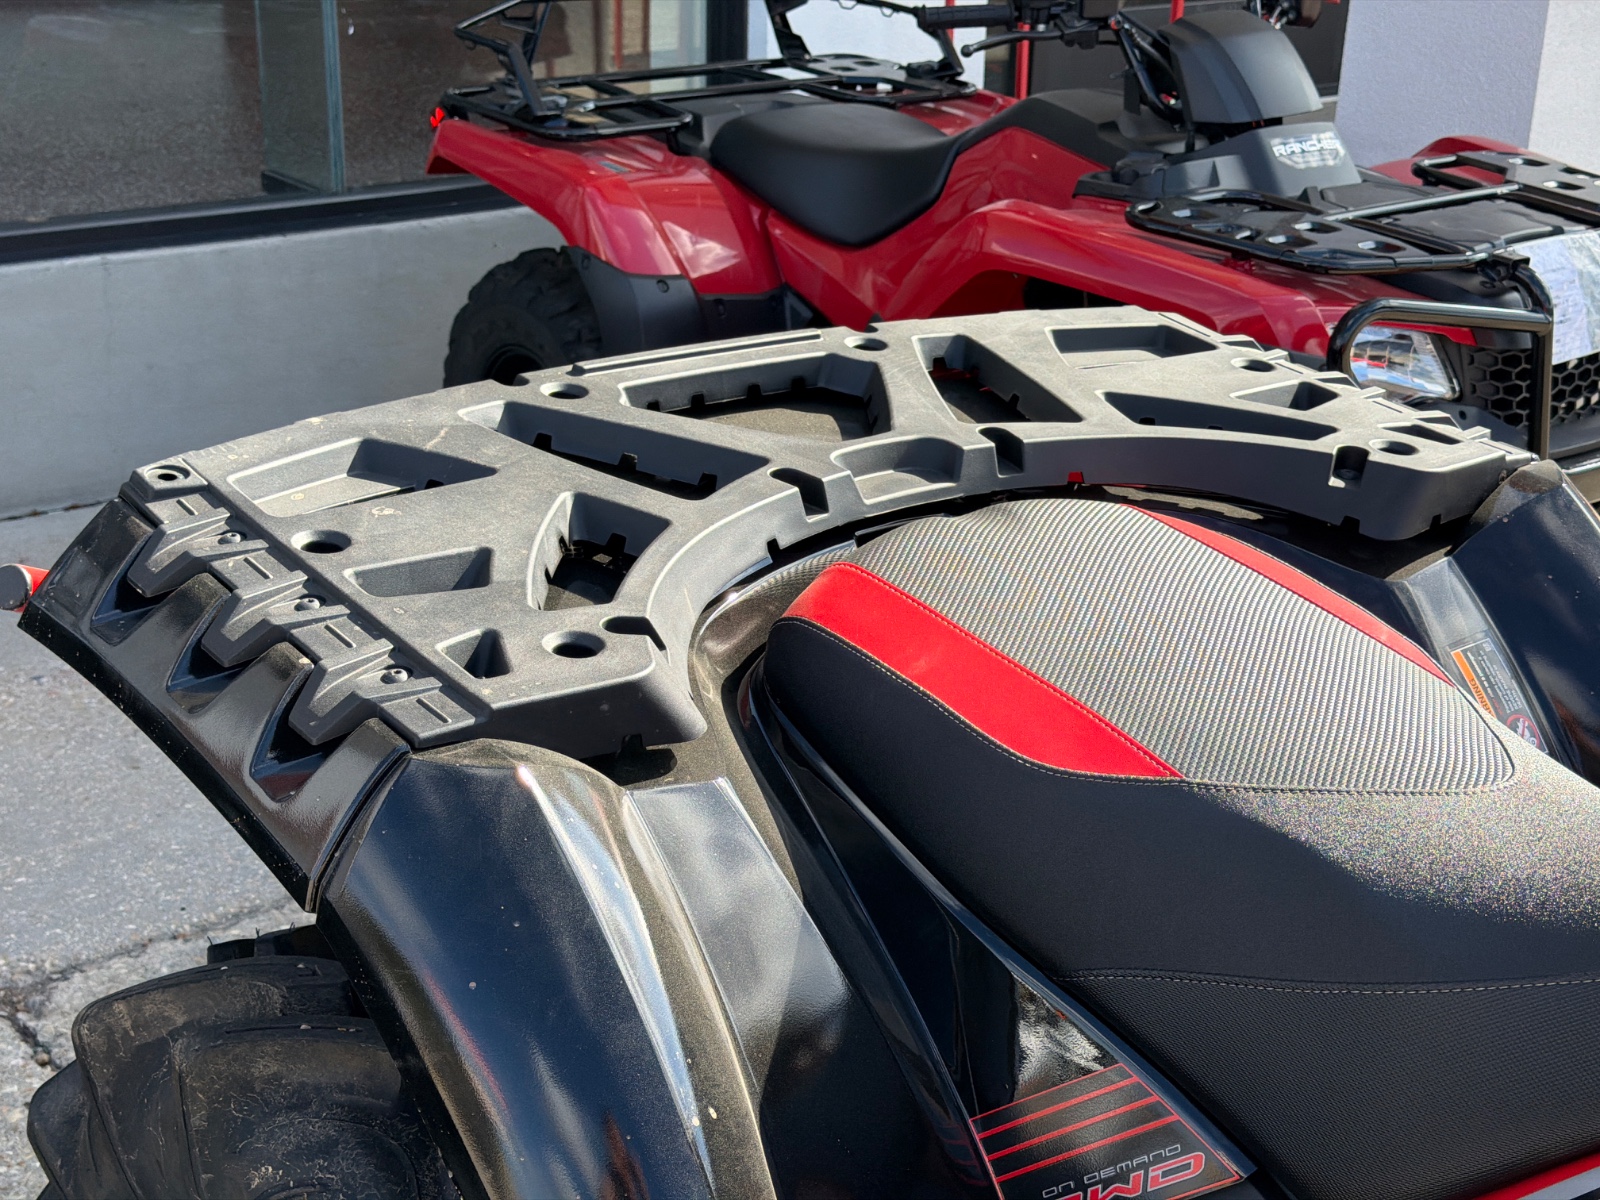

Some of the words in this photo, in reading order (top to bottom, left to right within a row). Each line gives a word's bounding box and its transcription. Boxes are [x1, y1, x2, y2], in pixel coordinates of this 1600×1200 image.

[1468, 677, 1494, 716] RNING
[1042, 1180, 1075, 1198] ON
[1083, 1144, 1181, 1184] DEMAND
[1055, 1152, 1205, 1200] WD
